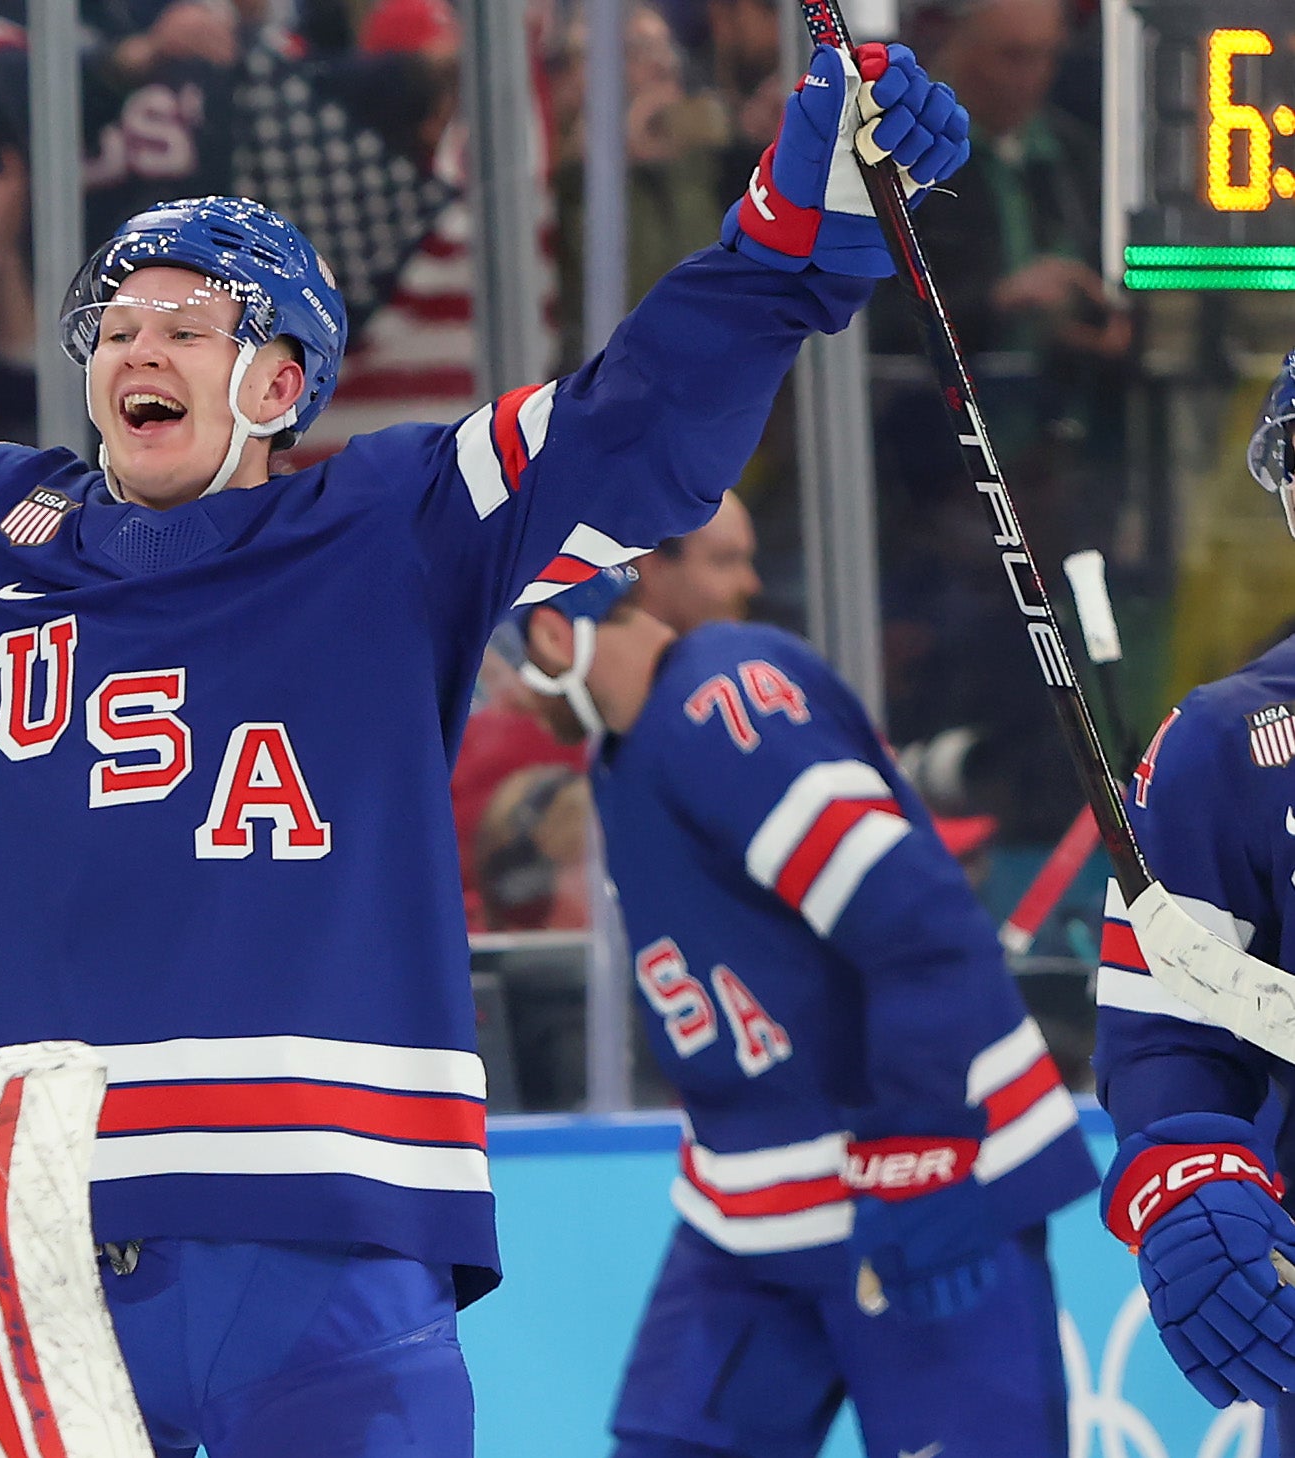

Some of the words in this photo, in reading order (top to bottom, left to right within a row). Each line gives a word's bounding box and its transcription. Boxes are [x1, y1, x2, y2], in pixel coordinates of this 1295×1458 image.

[301, 287, 338, 334] BAUER
[33, 491, 67, 510] USA
[958, 400, 1073, 687] TRUE
[683, 659, 811, 754] 74
[1252, 703, 1290, 727] USA
